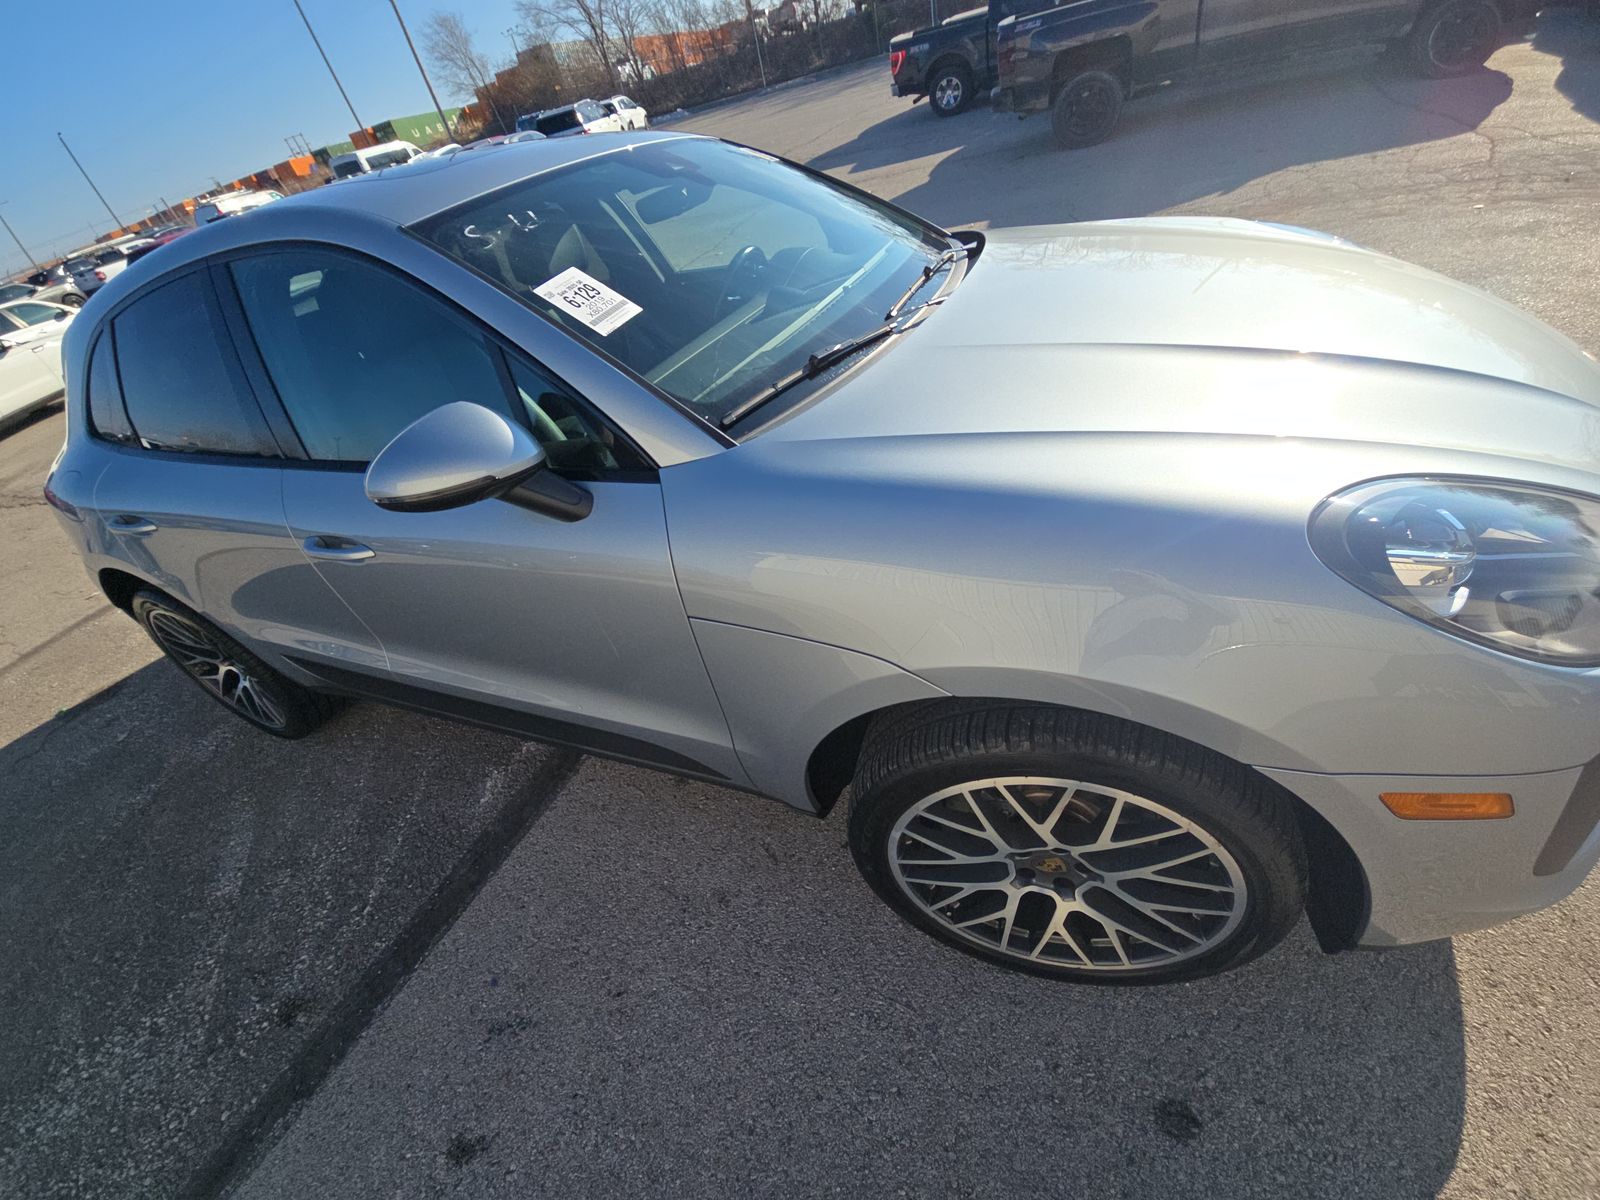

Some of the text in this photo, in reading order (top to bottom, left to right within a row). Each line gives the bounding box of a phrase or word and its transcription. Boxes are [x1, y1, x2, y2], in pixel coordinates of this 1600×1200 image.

[411, 120, 456, 138] UASC
[563, 283, 601, 308] 6:129
[585, 296, 606, 310] 2019
